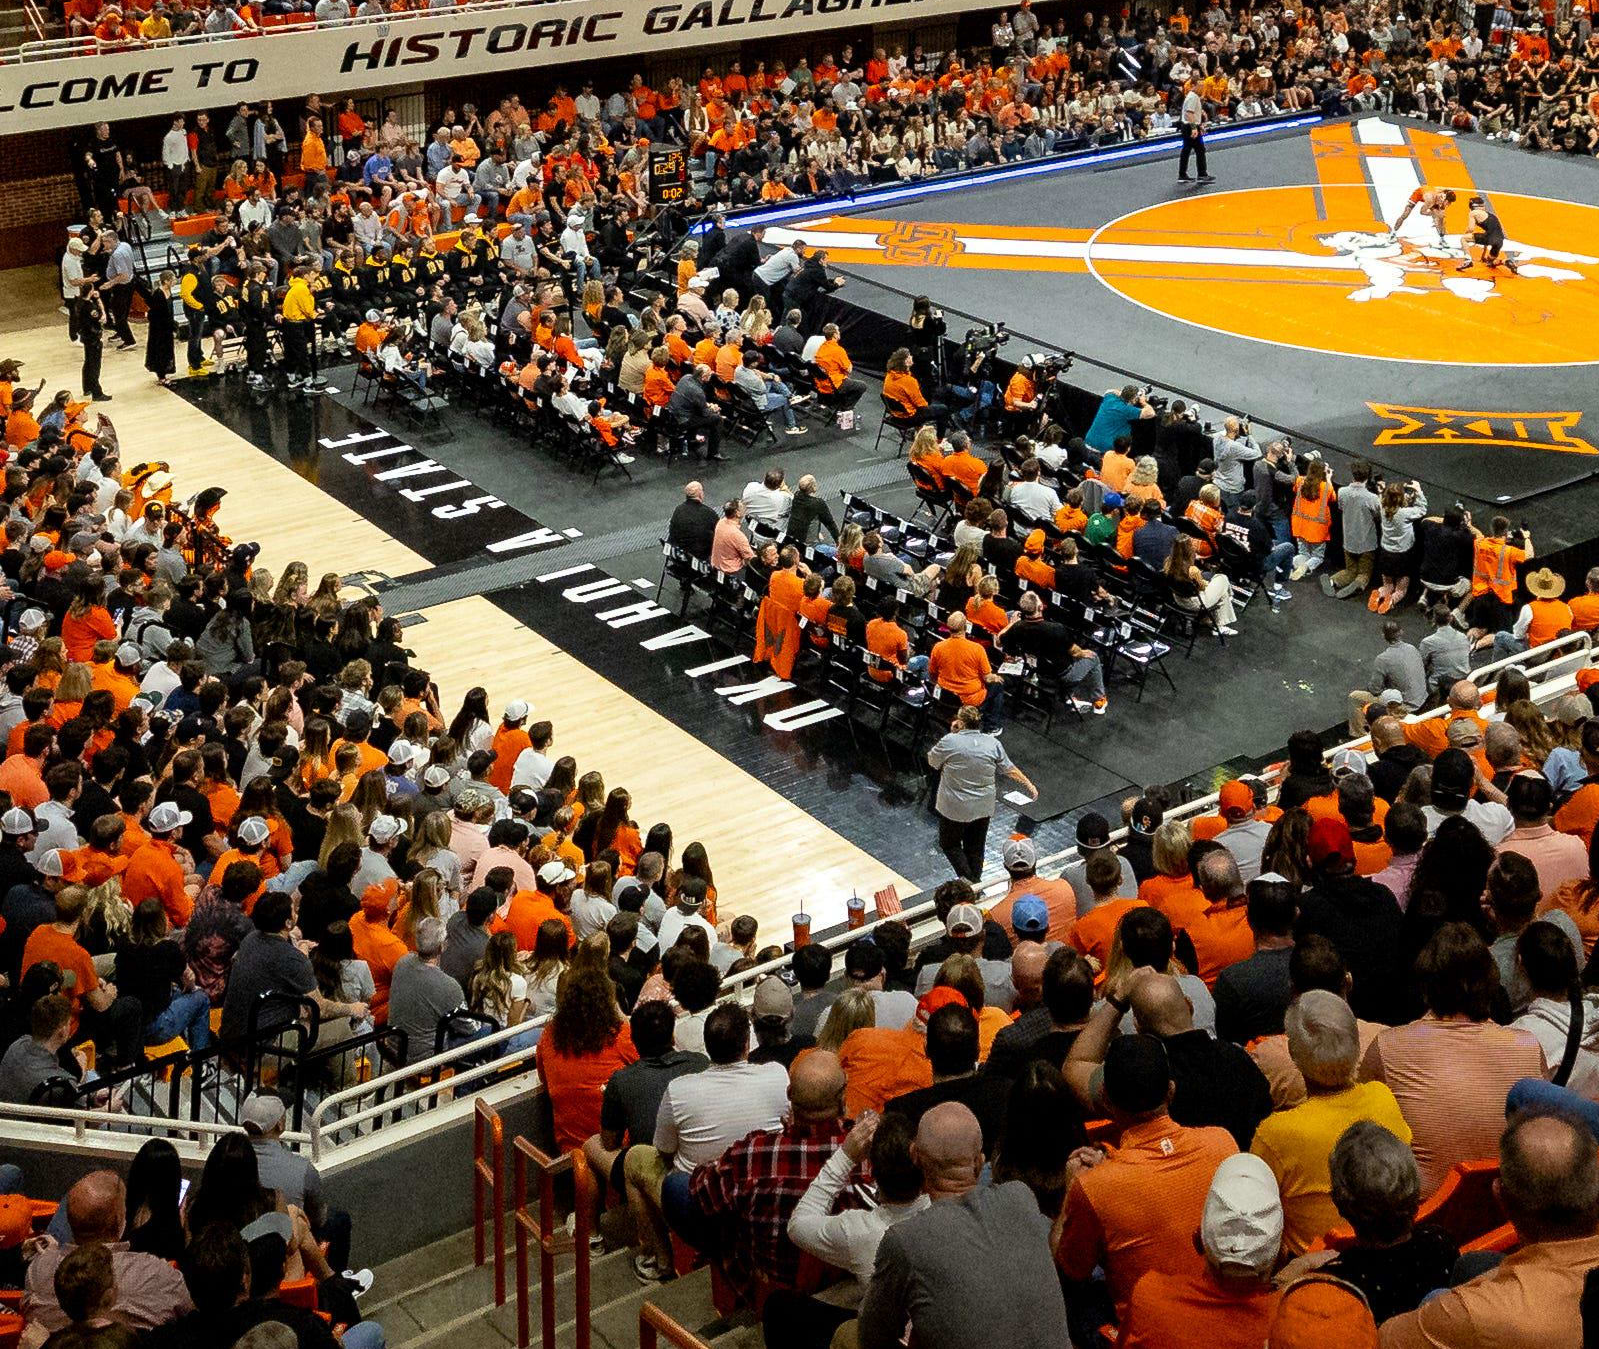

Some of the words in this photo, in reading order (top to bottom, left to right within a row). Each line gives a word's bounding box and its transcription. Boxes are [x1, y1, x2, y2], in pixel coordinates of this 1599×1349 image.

[191, 58, 260, 89] TO
[340, 11, 624, 73] HISTORIC
[662, 187, 683, 200] 0:02
[316, 426, 507, 520] STATE
[487, 526, 846, 733] OKLAHOA
